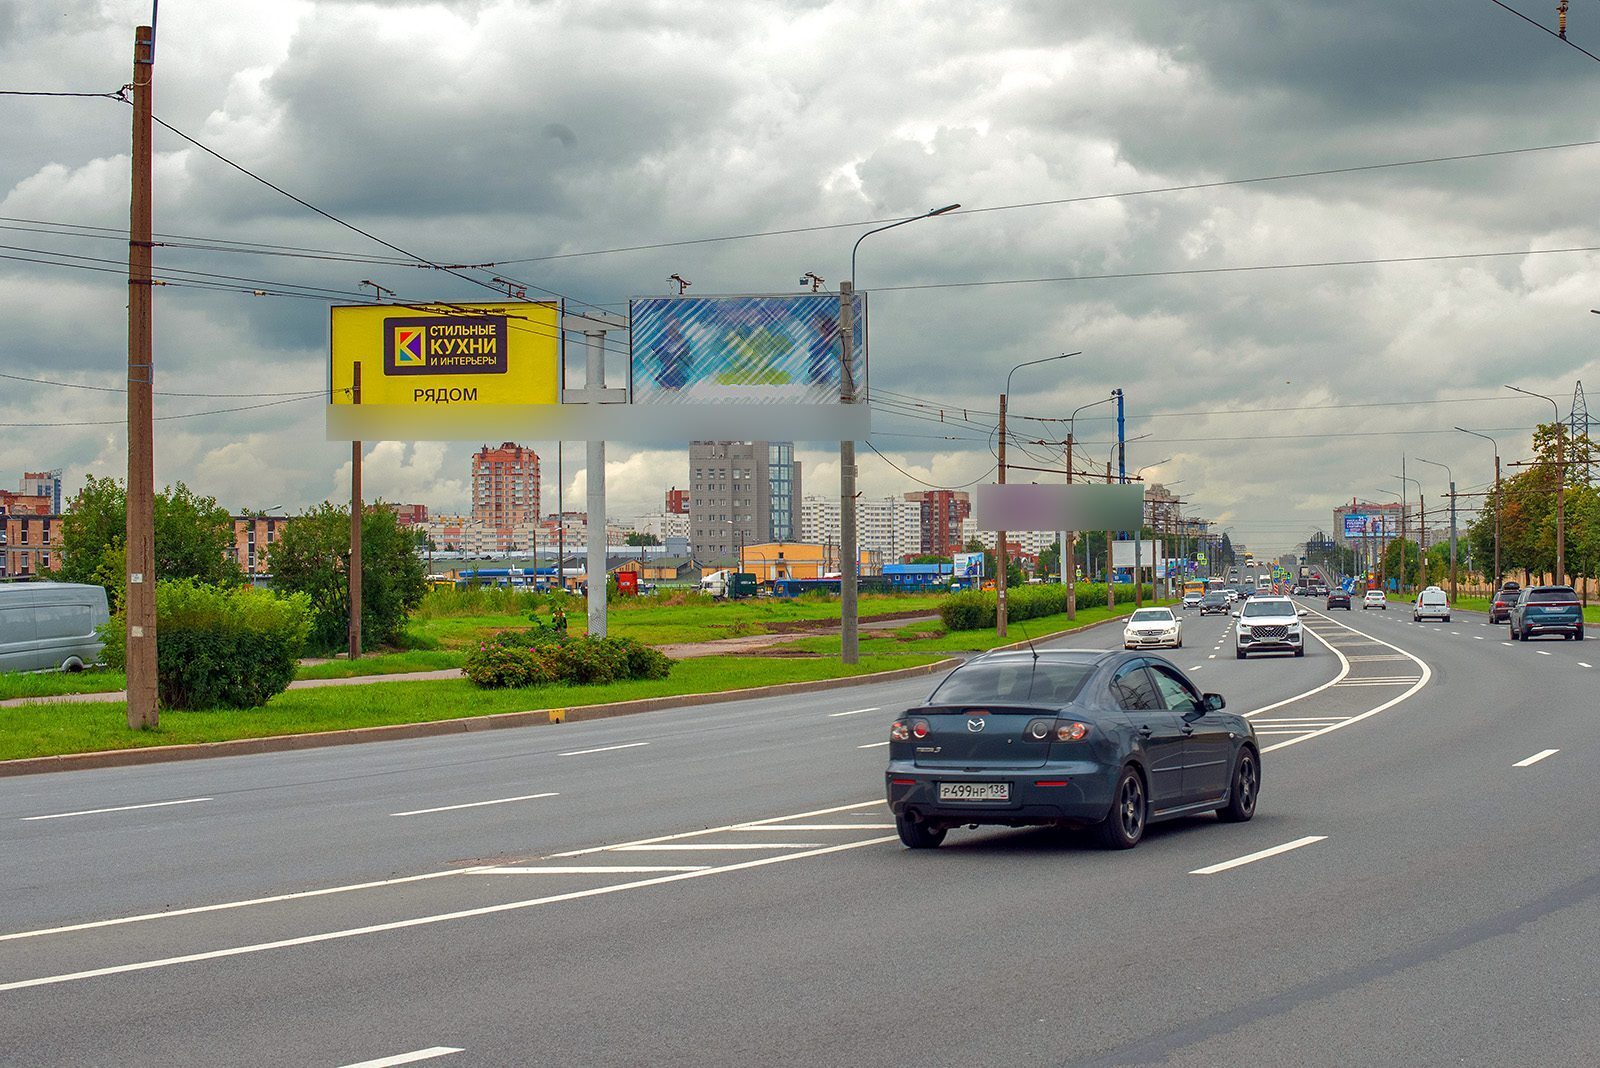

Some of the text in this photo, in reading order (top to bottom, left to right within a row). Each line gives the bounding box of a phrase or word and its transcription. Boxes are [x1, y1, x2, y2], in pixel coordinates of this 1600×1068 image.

[430, 324, 497, 336] СТИЛЬНЫЕ
[430, 338, 497, 355] КУХНИ
[430, 356, 497, 366] И ИНТЕРЬЕРЫ
[414, 388, 478, 404] РЯДОМ
